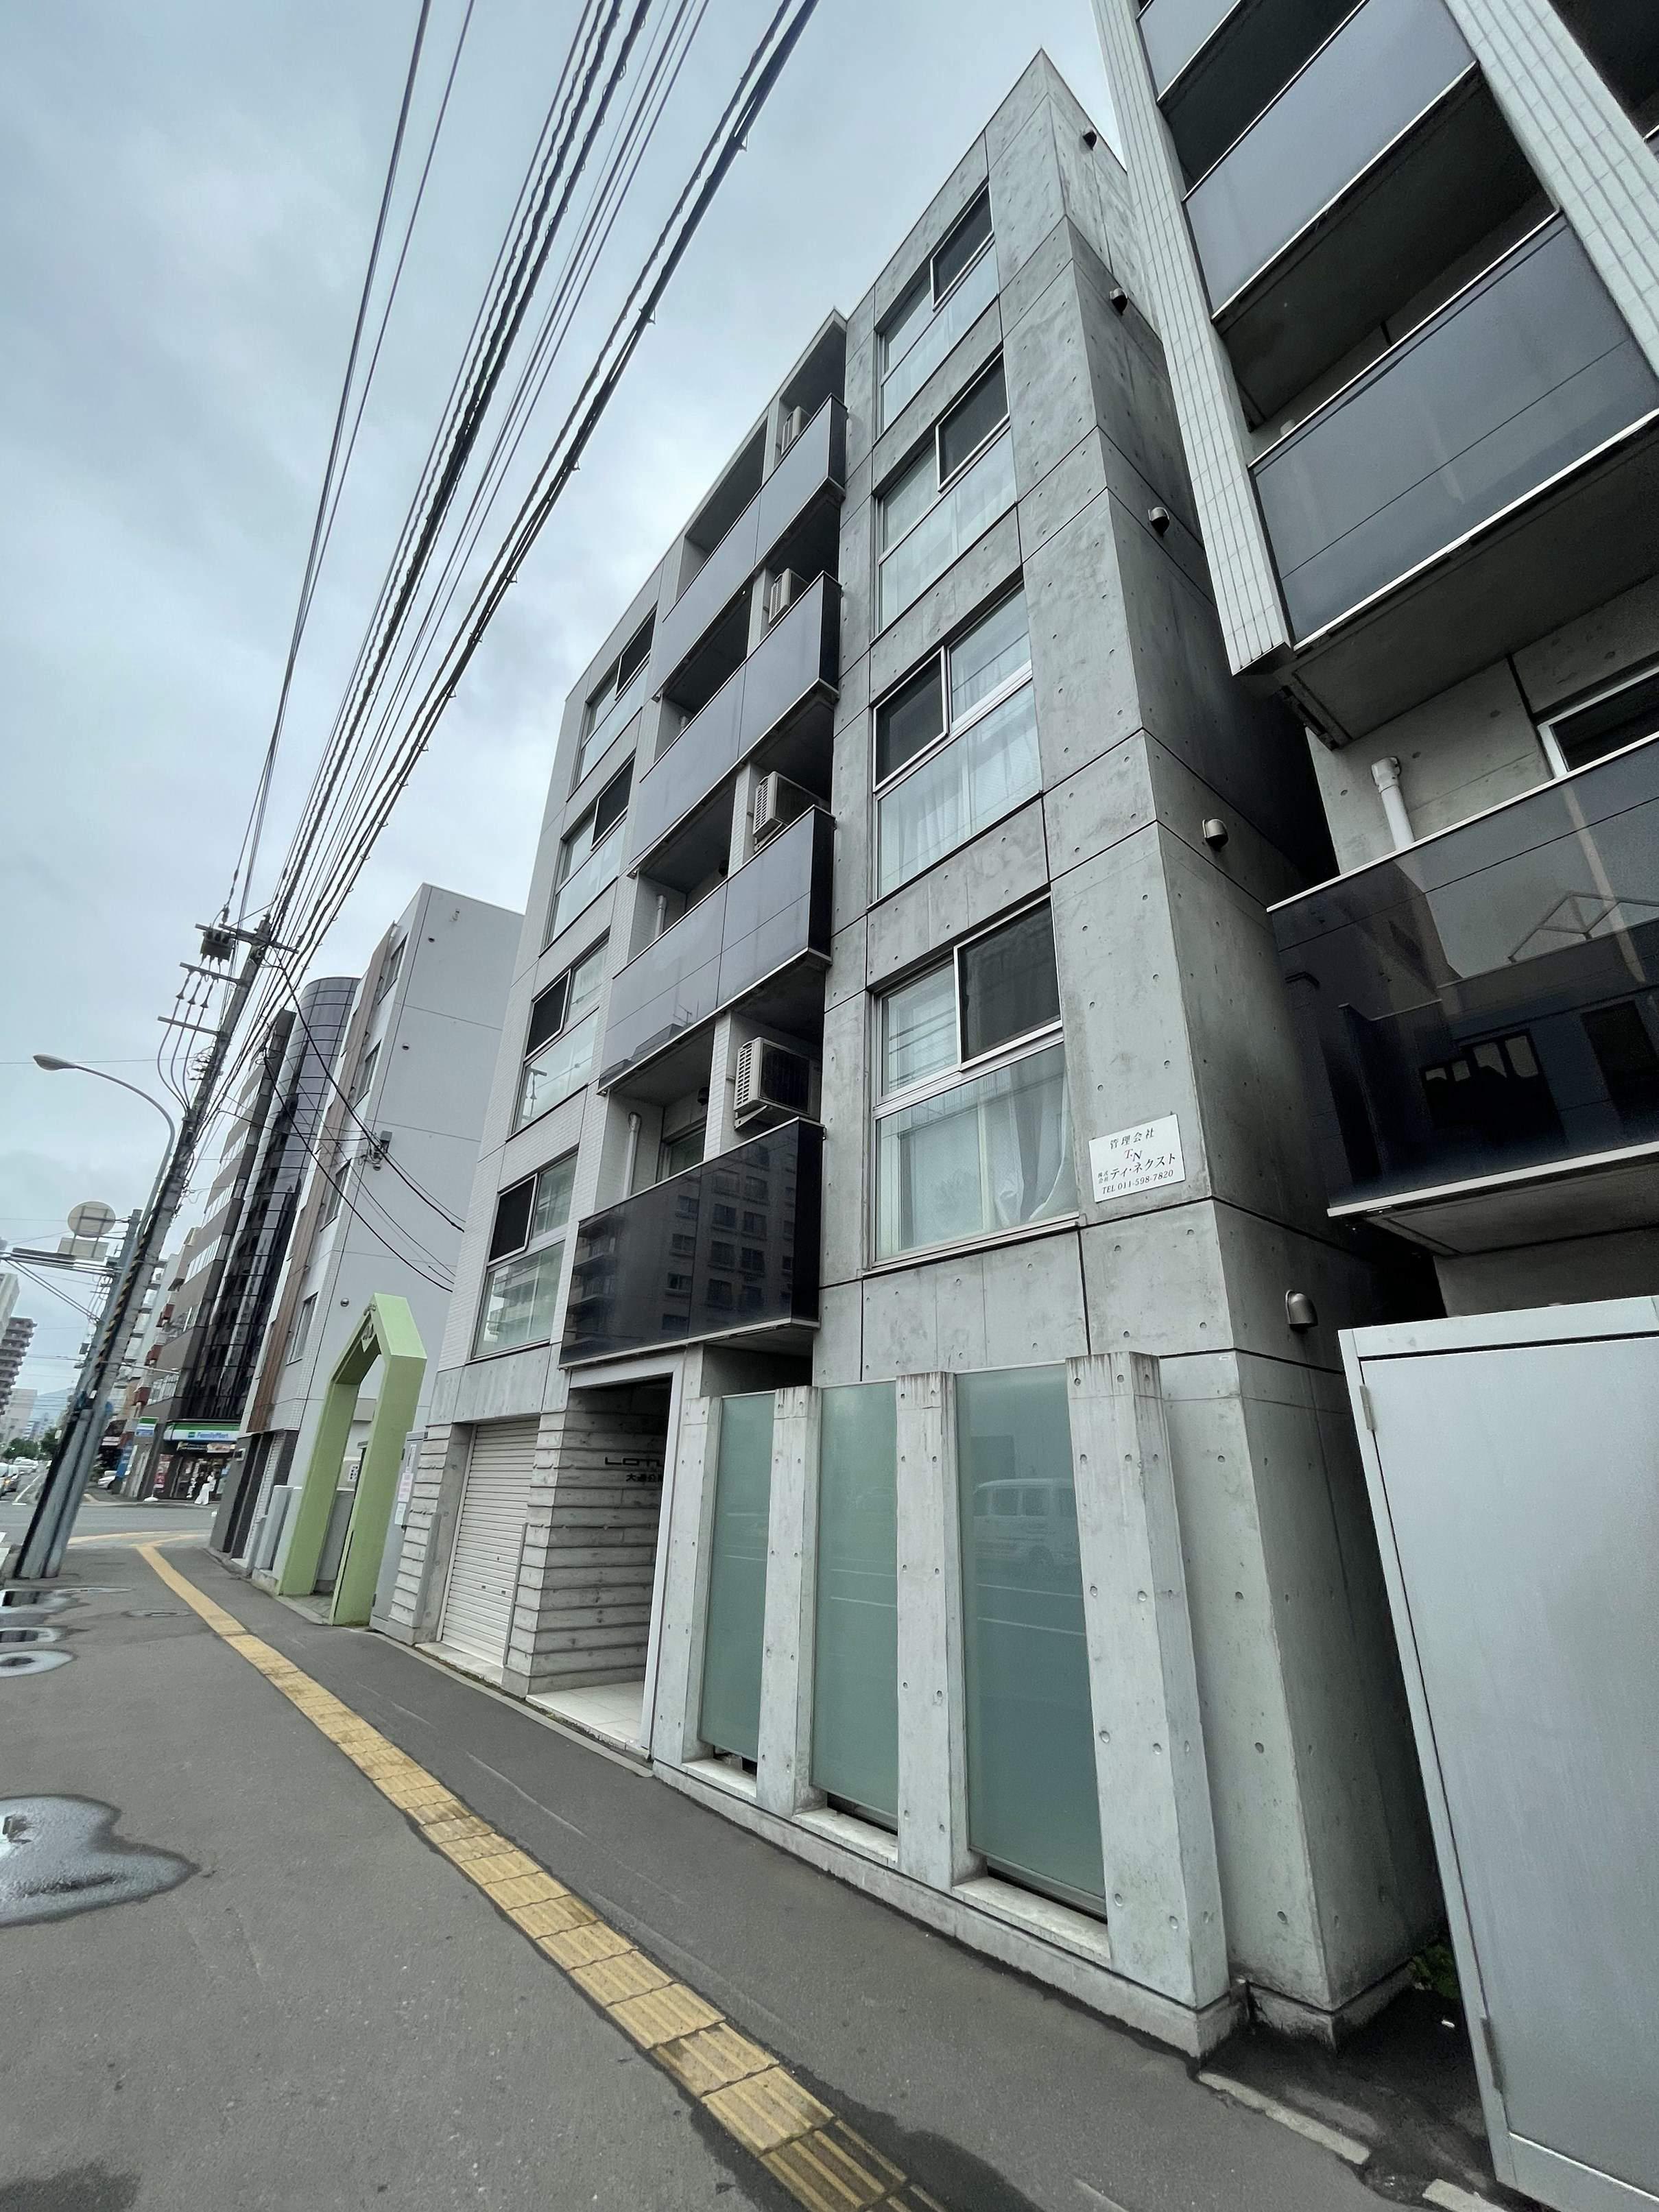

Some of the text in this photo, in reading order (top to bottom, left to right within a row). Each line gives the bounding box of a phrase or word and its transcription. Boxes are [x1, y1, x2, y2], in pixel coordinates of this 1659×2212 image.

[1110, 1127, 1155, 1150] 管理会社
[1102, 1169, 1174, 1195] TEL 011-598-7820
